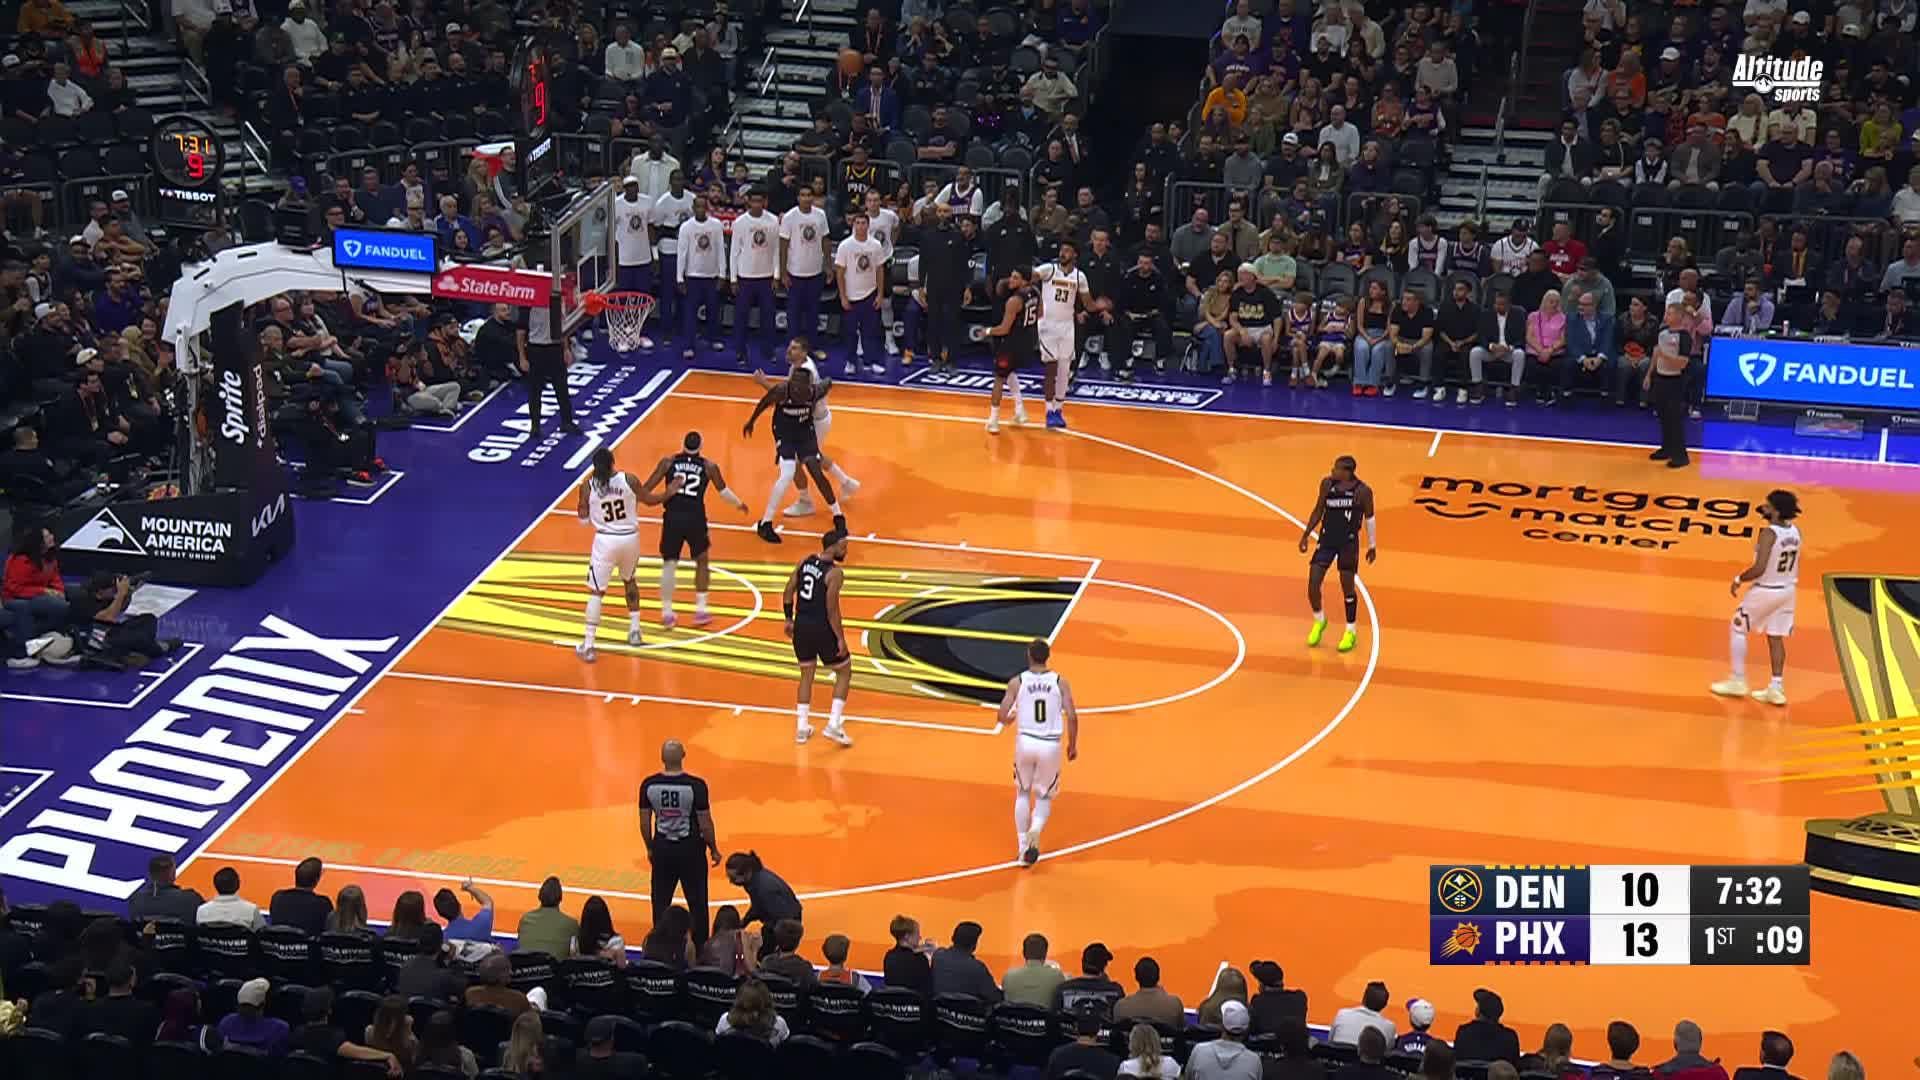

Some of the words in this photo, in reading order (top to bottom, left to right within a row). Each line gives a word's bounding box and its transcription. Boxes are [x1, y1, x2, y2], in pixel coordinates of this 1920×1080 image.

[175, 134, 210, 155] 7:31
[187, 154, 204, 177] 9
[364, 244, 427, 261] FANDUEL
[460, 277, 497, 293] State
[499, 281, 535, 300] Farm
[1055, 287, 1069, 303] 23
[1023, 306, 1037, 327] 15
[1783, 361, 1915, 389] FANDUEL
[217, 369, 250, 445] Sprite
[601, 498, 626, 523] 32
[1344, 510, 1352, 522] 4
[141, 516, 232, 538] MOUNTAIN
[145, 533, 225, 553] AMERICA
[1522, 527, 1681, 550] center
[1777, 550, 1797, 572] 27
[799, 575, 814, 600] 3
[1034, 699, 1047, 723] 0
[0, 614, 399, 900] PHOENIX
[661, 790, 680, 808] 28
